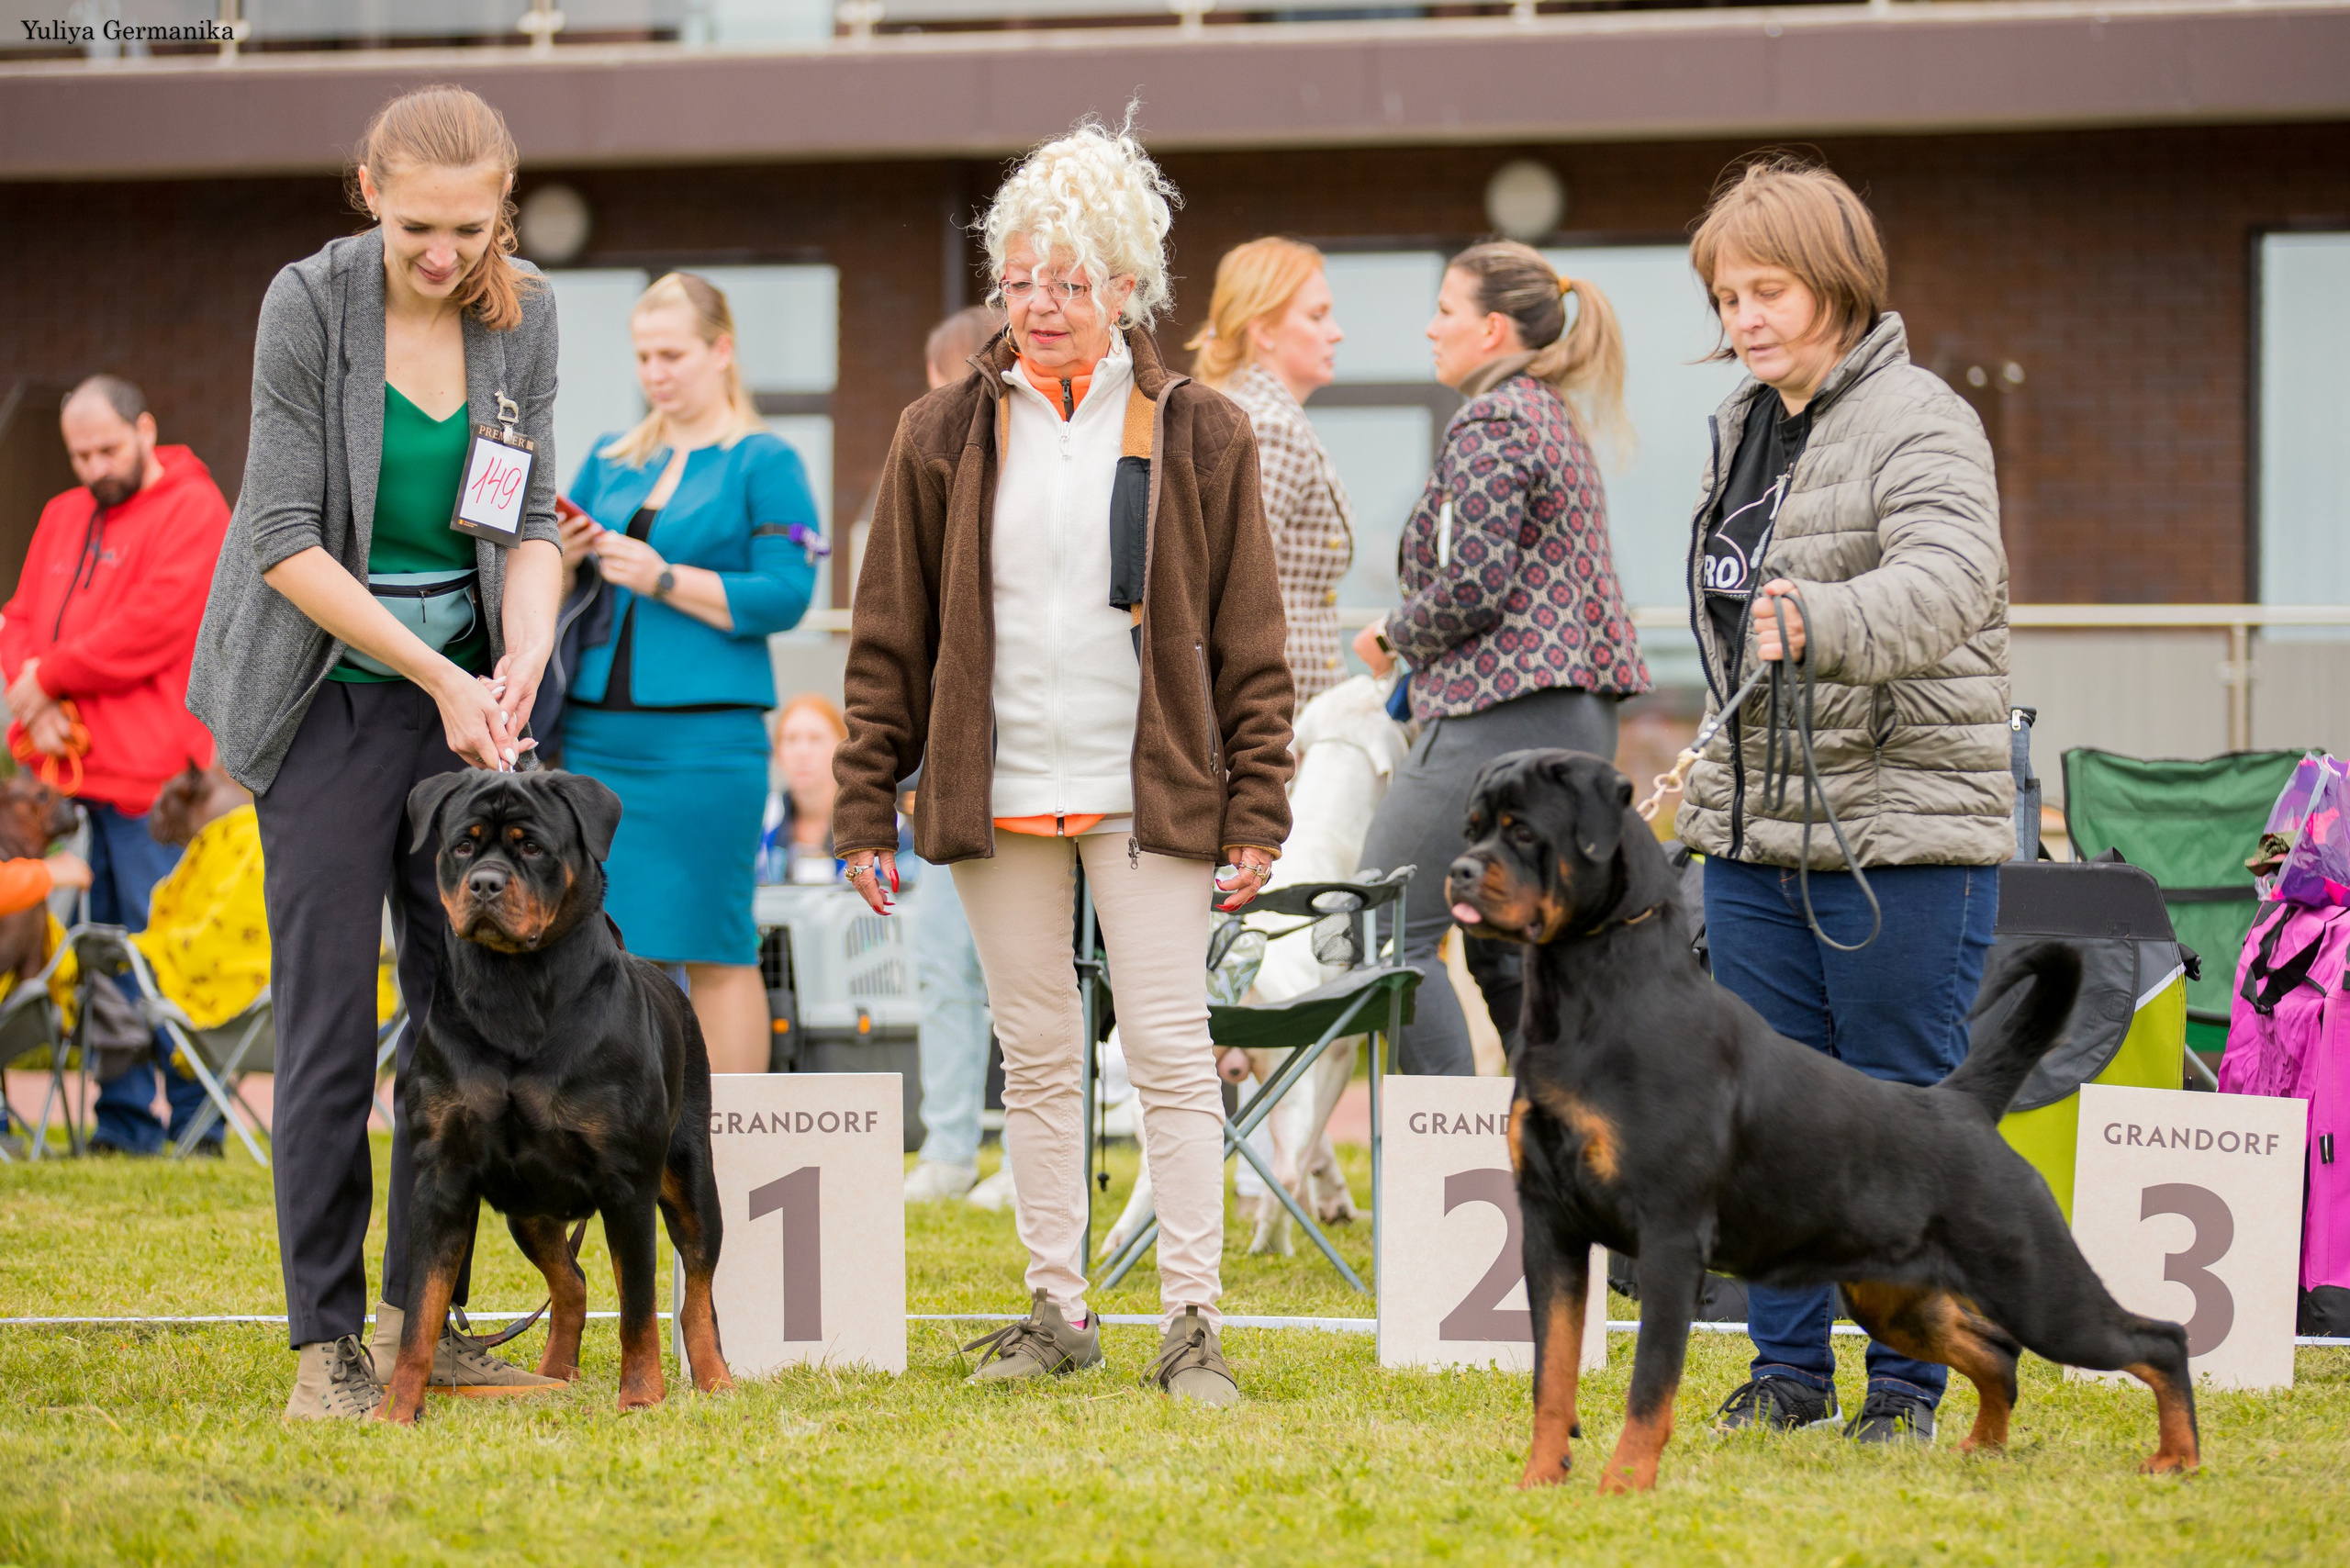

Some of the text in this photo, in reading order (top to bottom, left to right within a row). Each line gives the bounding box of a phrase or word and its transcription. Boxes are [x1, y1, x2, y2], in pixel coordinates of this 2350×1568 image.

[478, 424, 526, 448] PREMER
[471, 456, 522, 510] 149
[710, 1111, 878, 1134] GRANDORF
[2103, 1122, 2280, 1156] GRANDORF
[748, 1166, 822, 1342] 1
[1439, 1168, 1536, 1342] 2
[2140, 1182, 2235, 1359] 3
